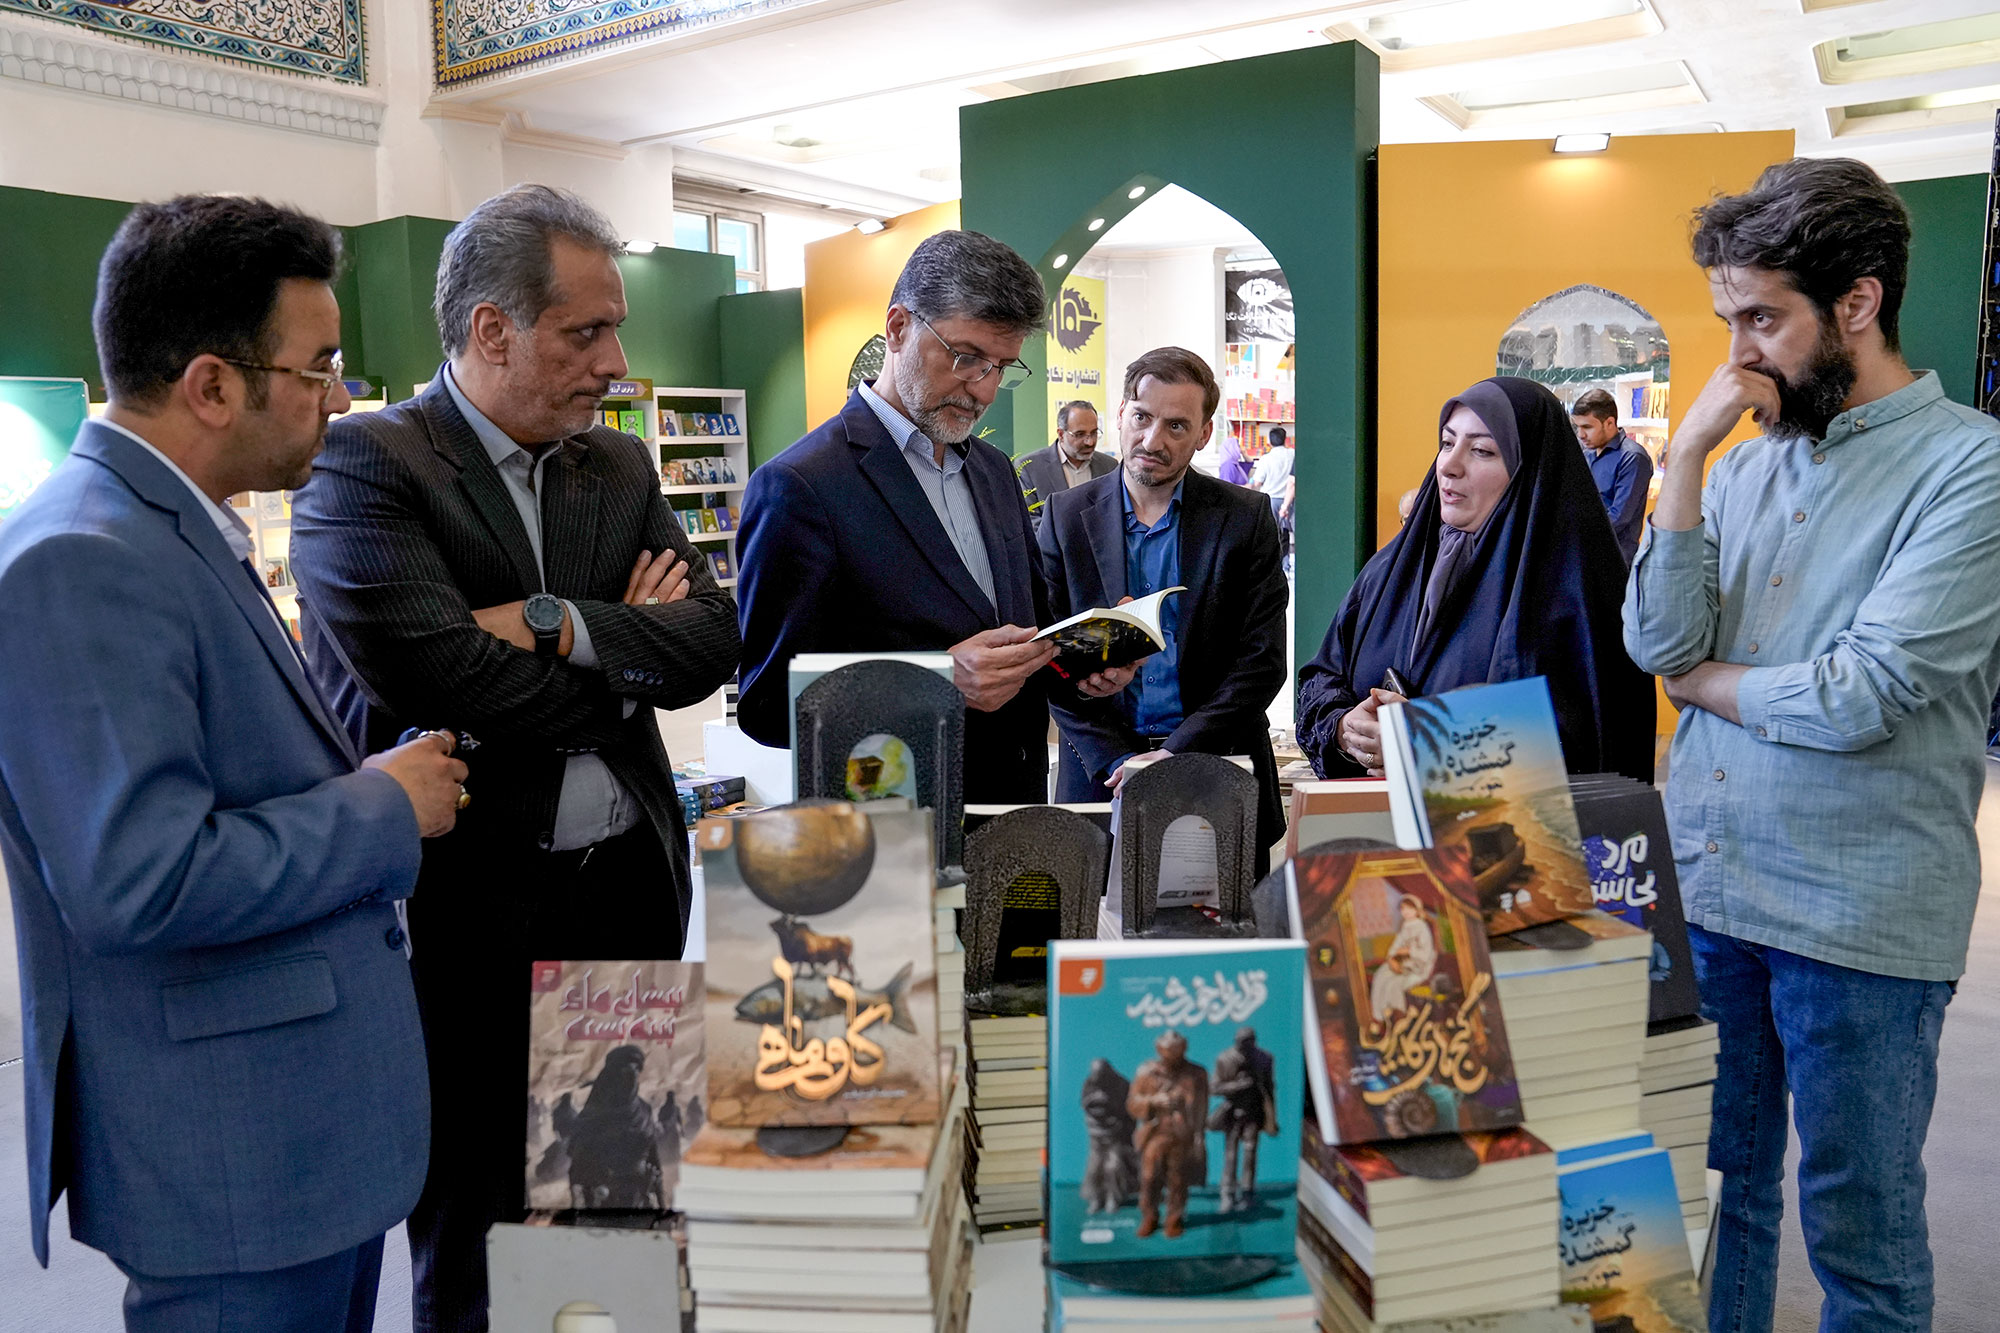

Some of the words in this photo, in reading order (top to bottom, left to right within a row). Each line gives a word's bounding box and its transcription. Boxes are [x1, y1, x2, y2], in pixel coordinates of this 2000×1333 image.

[1066, 369, 1101, 389] انتشارات
[1450, 720, 1497, 750] جزیره
[1446, 741, 1515, 777] گمشده
[1601, 833, 1649, 876] مرد
[1125, 976, 1221, 1028] خورشید
[1564, 1200, 1615, 1236] جزیره
